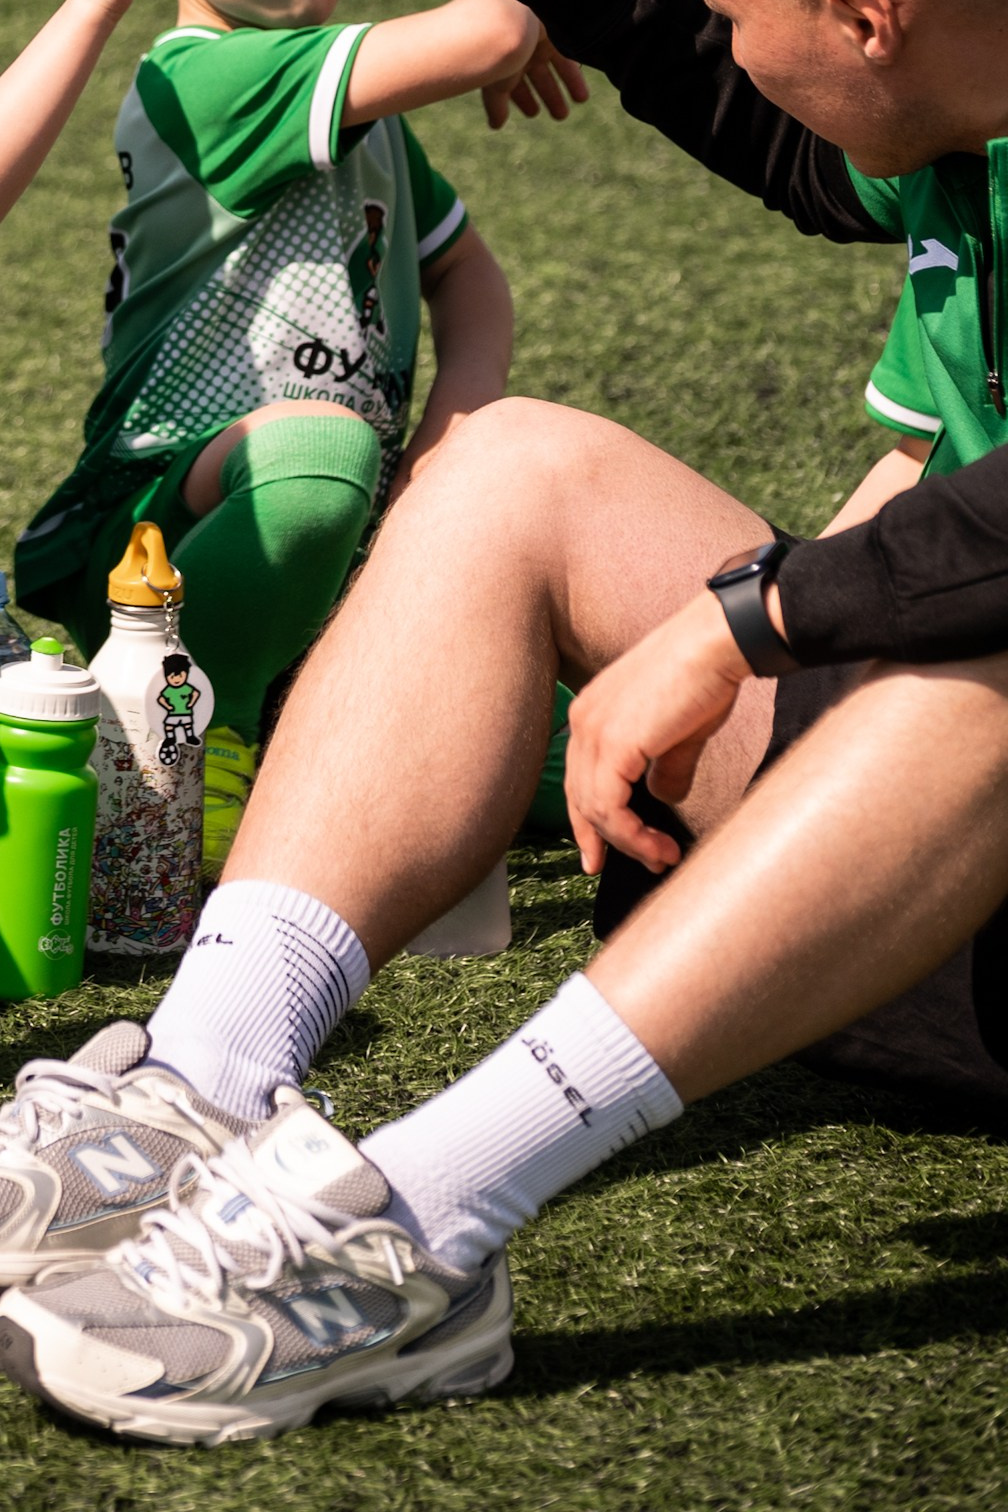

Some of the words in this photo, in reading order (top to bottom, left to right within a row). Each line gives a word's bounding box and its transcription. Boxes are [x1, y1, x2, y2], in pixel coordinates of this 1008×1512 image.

[50, 828, 71, 926] ФУТБОЛИКА
[66, 867, 74, 900] ФУТБОЛА
[68, 1131, 163, 1197] N
